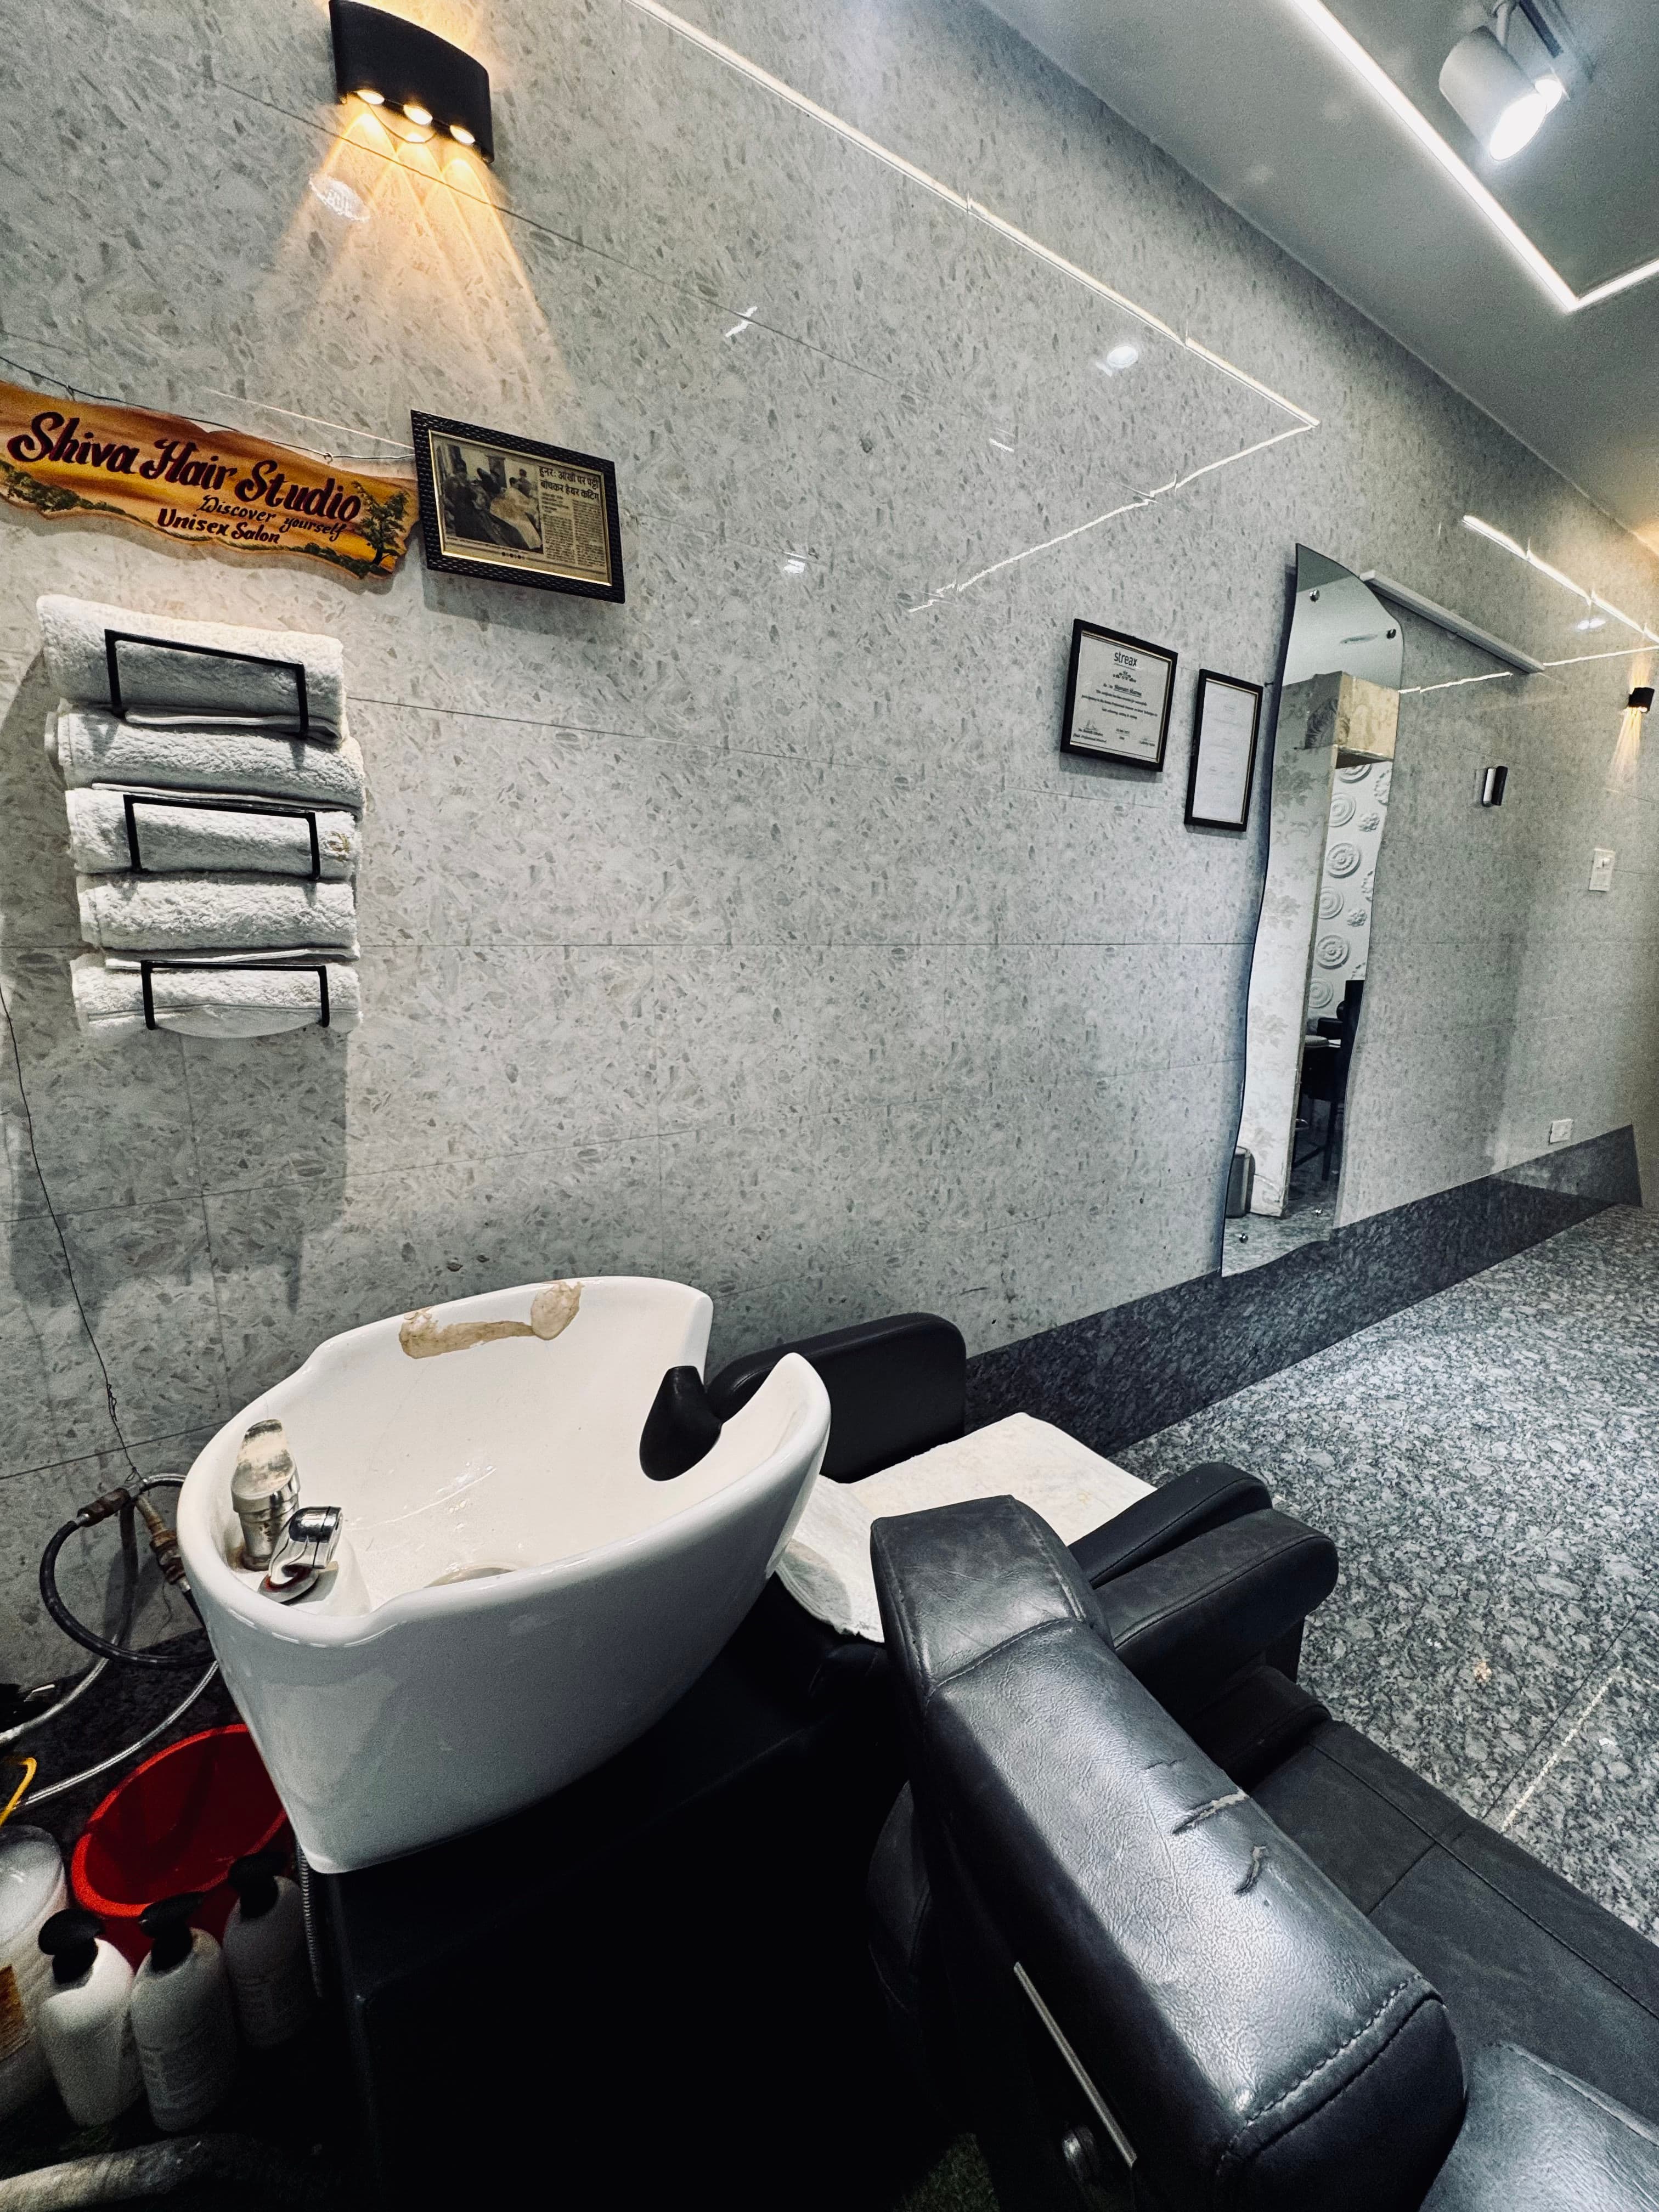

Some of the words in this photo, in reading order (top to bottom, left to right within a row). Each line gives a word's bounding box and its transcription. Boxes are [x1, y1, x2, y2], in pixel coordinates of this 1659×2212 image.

[7, 411, 139, 474] Shiva
[139, 438, 238, 490] Hair
[234, 460, 362, 522] Studio
[157, 508, 228, 536] Unisex
[231, 522, 280, 544] Salon
[197, 495, 276, 522] Discover
[279, 517, 347, 541] yourself
[1114, 651, 1138, 667] streax
